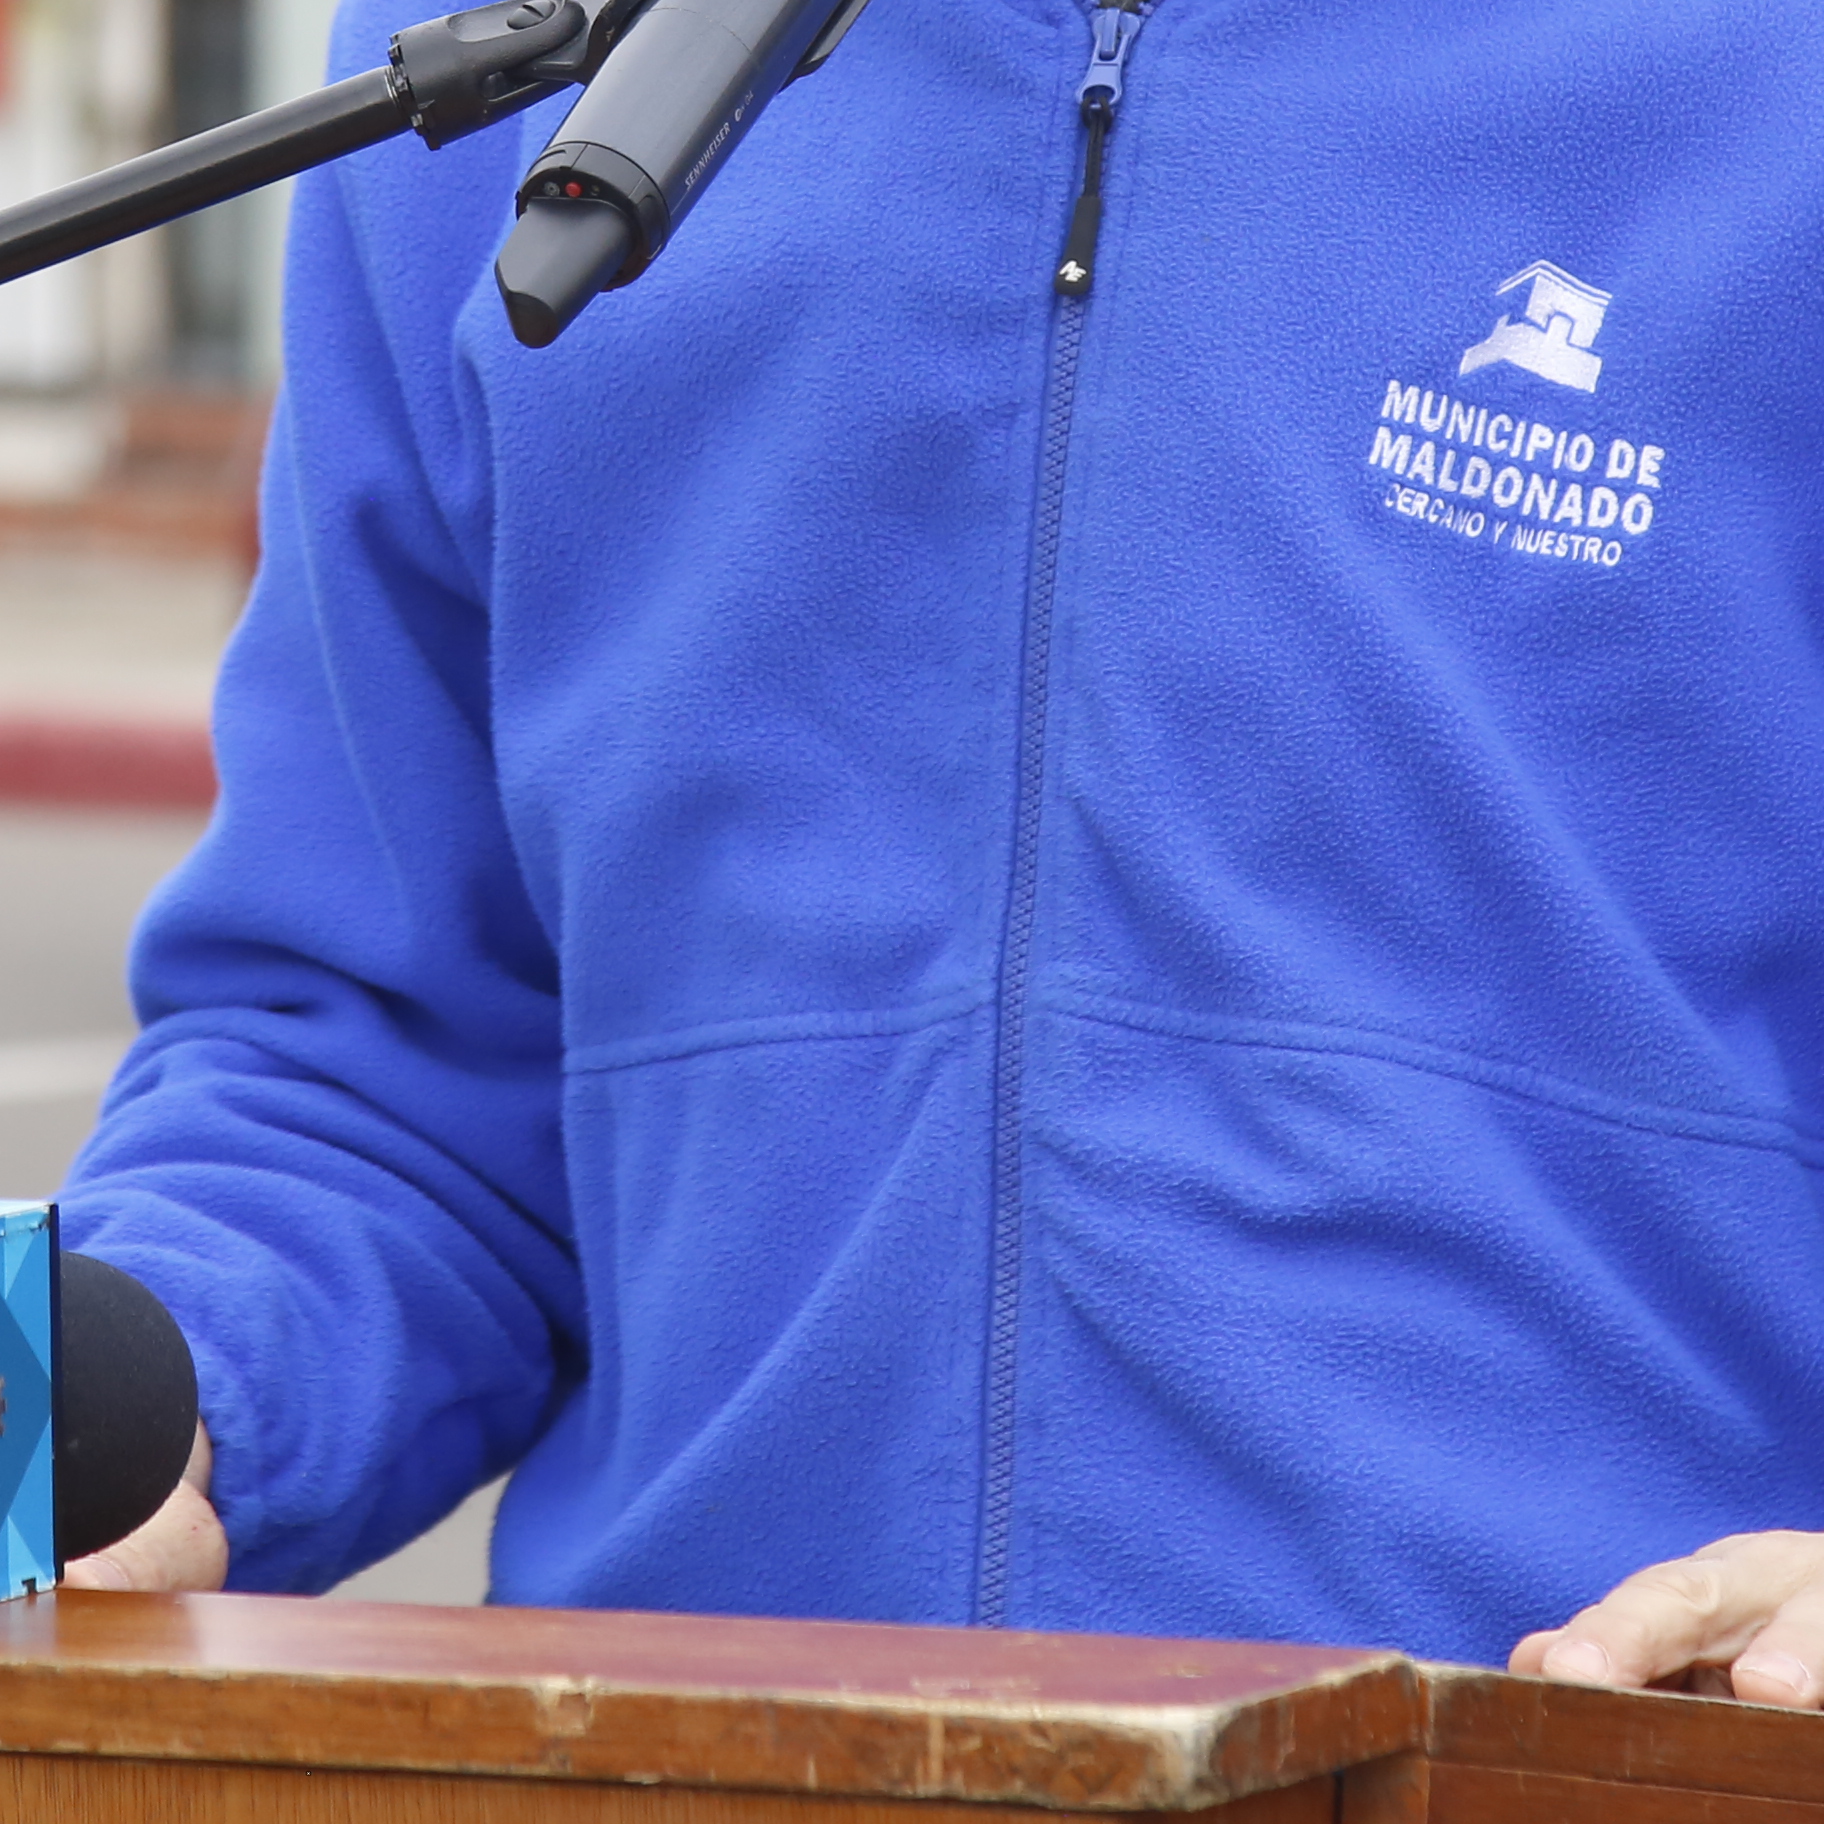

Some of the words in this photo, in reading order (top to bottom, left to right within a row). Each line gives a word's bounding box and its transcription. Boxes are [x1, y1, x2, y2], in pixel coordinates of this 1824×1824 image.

[684, 121, 731, 190] SENNHEISER
[1369, 426, 1654, 535] MALDONADO
[1381, 379, 1595, 472] MUNICIPIO
[1606, 439, 1666, 488] DE
[1384, 483, 1485, 538] CERCANO
[1493, 521, 1509, 545] Y
[1511, 525, 1623, 566] NUESTRO
